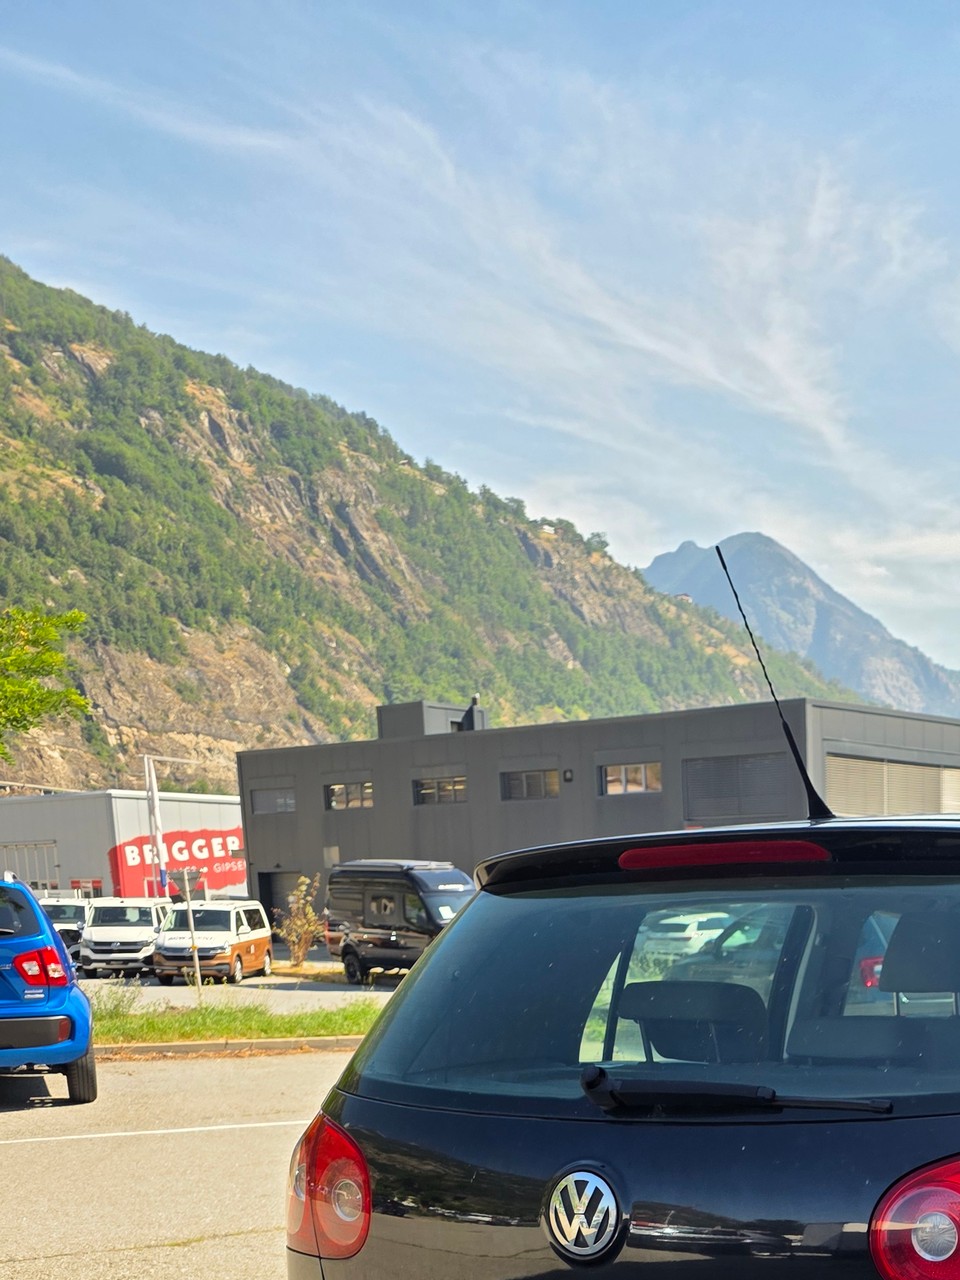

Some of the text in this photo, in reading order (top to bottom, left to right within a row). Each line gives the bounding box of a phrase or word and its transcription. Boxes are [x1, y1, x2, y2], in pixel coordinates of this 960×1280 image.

[124, 836, 240, 866] BRIGGER
[213, 860, 246, 874] GIPSE
[549, 1171, 617, 1255] VW
